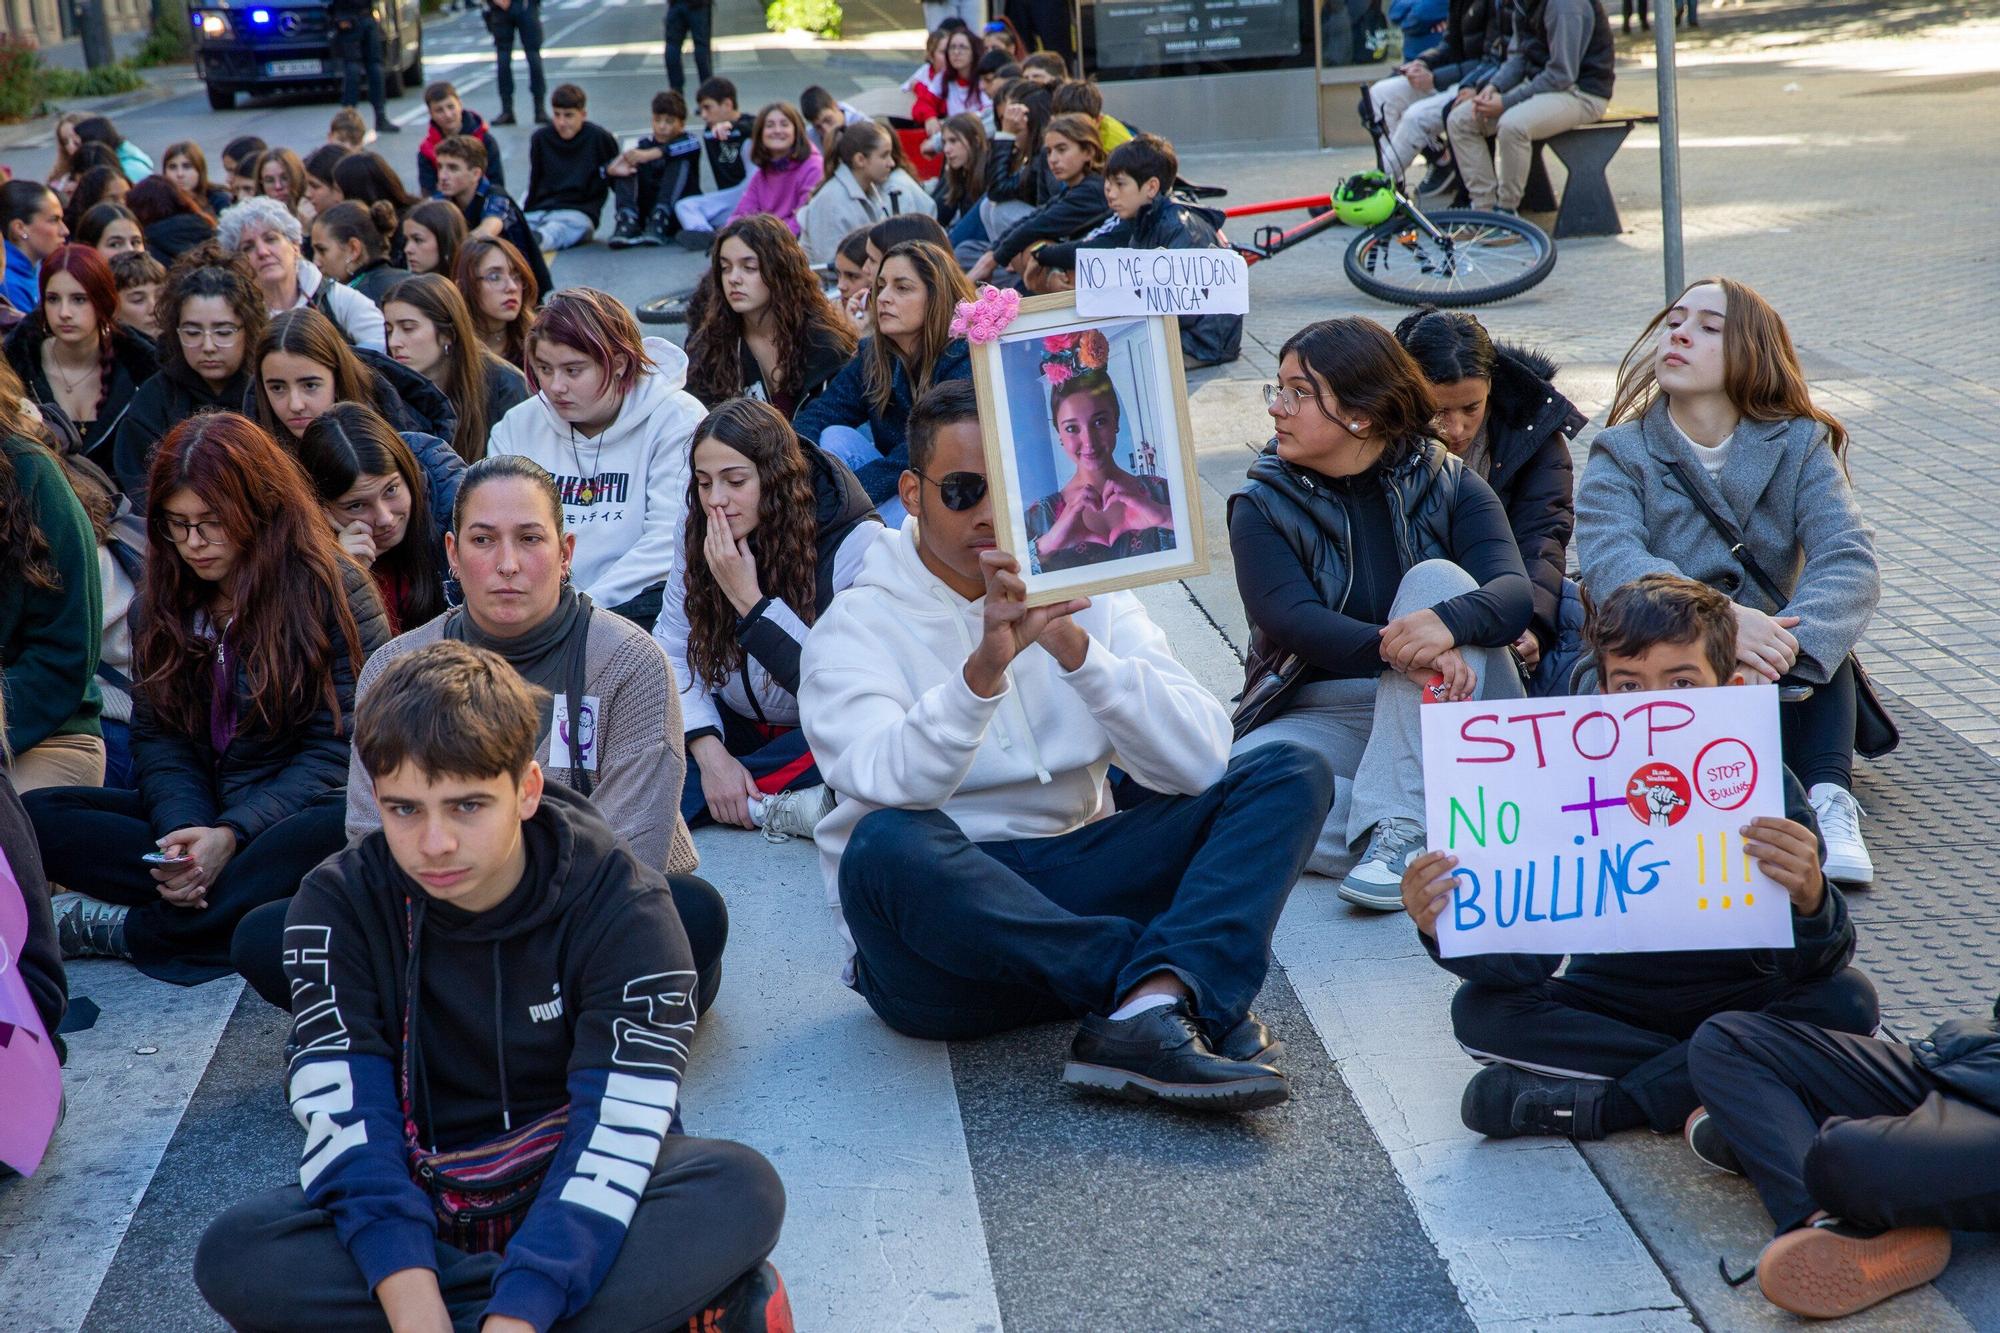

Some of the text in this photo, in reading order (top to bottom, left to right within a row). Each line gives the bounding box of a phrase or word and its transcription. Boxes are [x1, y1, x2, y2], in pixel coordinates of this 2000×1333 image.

[1079, 255, 1237, 289] NO ME OLVIDEN
[1146, 286, 1201, 313] NUNCA
[566, 510, 624, 524] モトデイズ
[1456, 701, 1695, 768] STOP
[1707, 761, 1746, 782] STOP
[529, 995, 564, 1024] PUM
